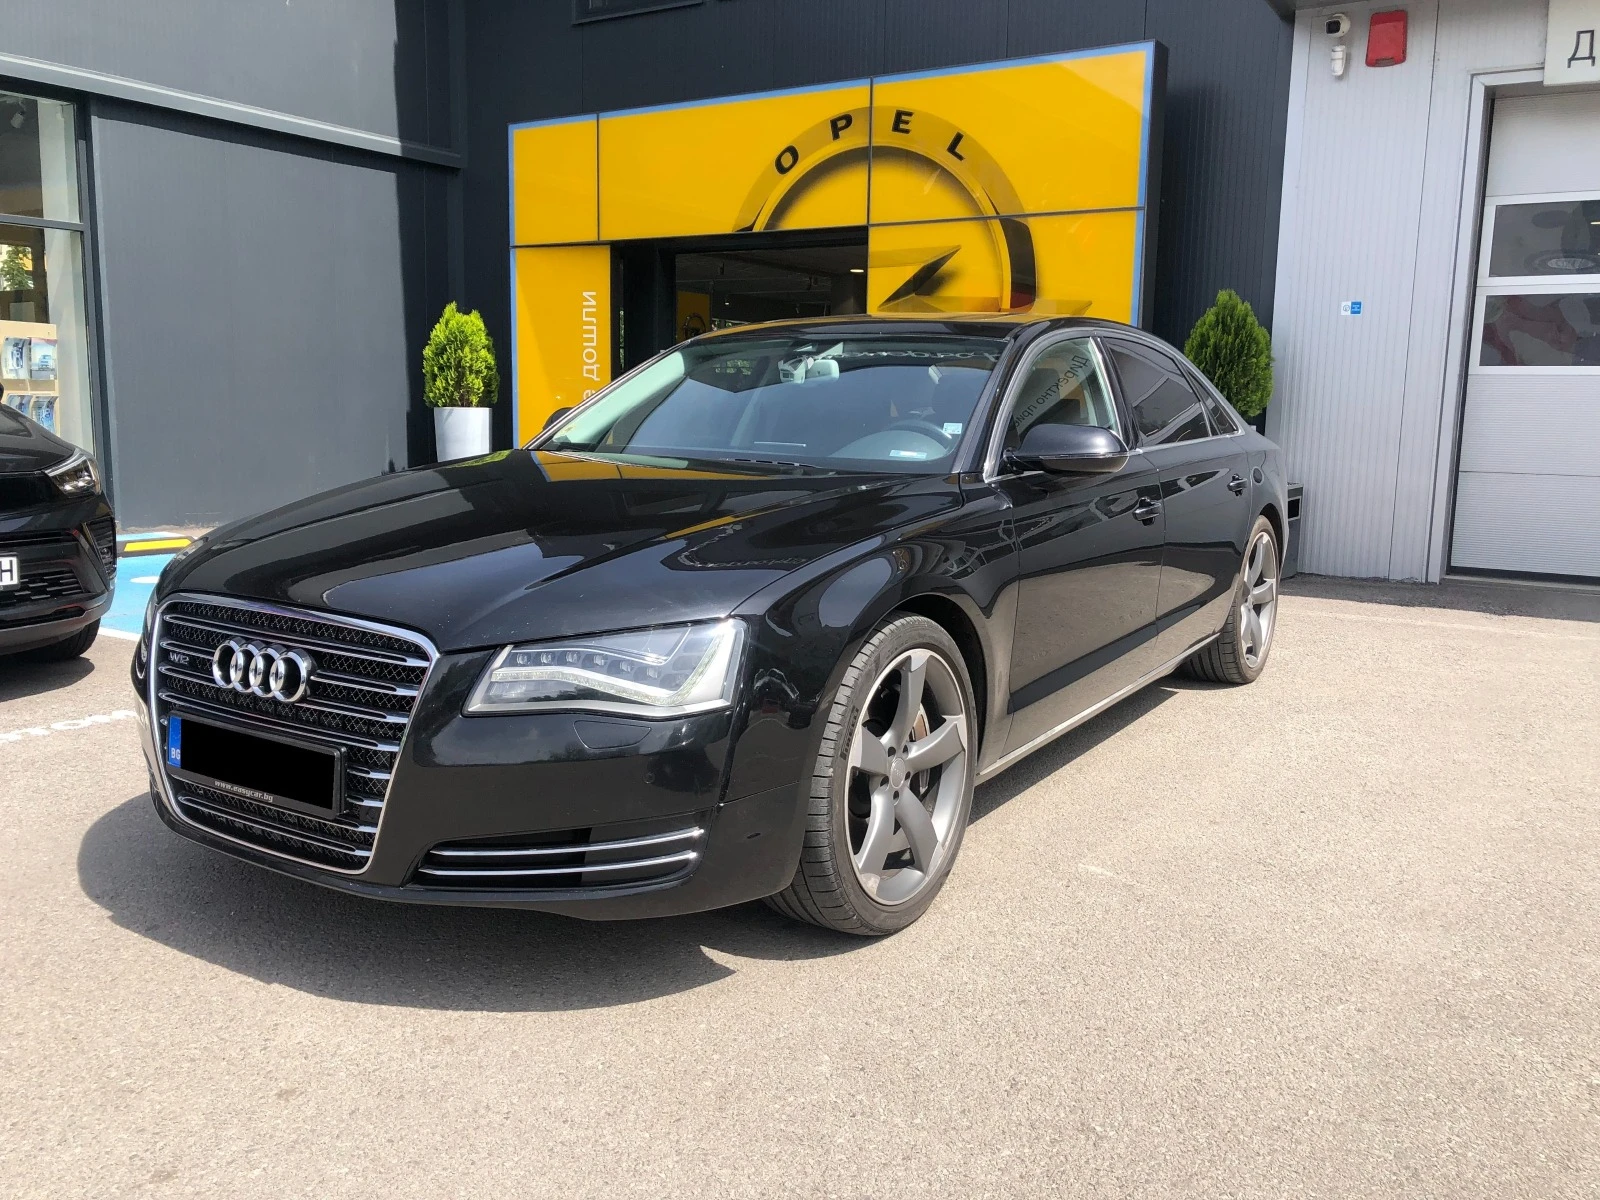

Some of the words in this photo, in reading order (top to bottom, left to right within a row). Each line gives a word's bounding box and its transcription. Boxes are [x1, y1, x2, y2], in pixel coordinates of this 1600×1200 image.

[775, 109, 965, 174] OPEL
[582, 291, 600, 381] дошли
[170, 747, 181, 760] BG
[214, 780, 274, 803] www.easycar.bg
